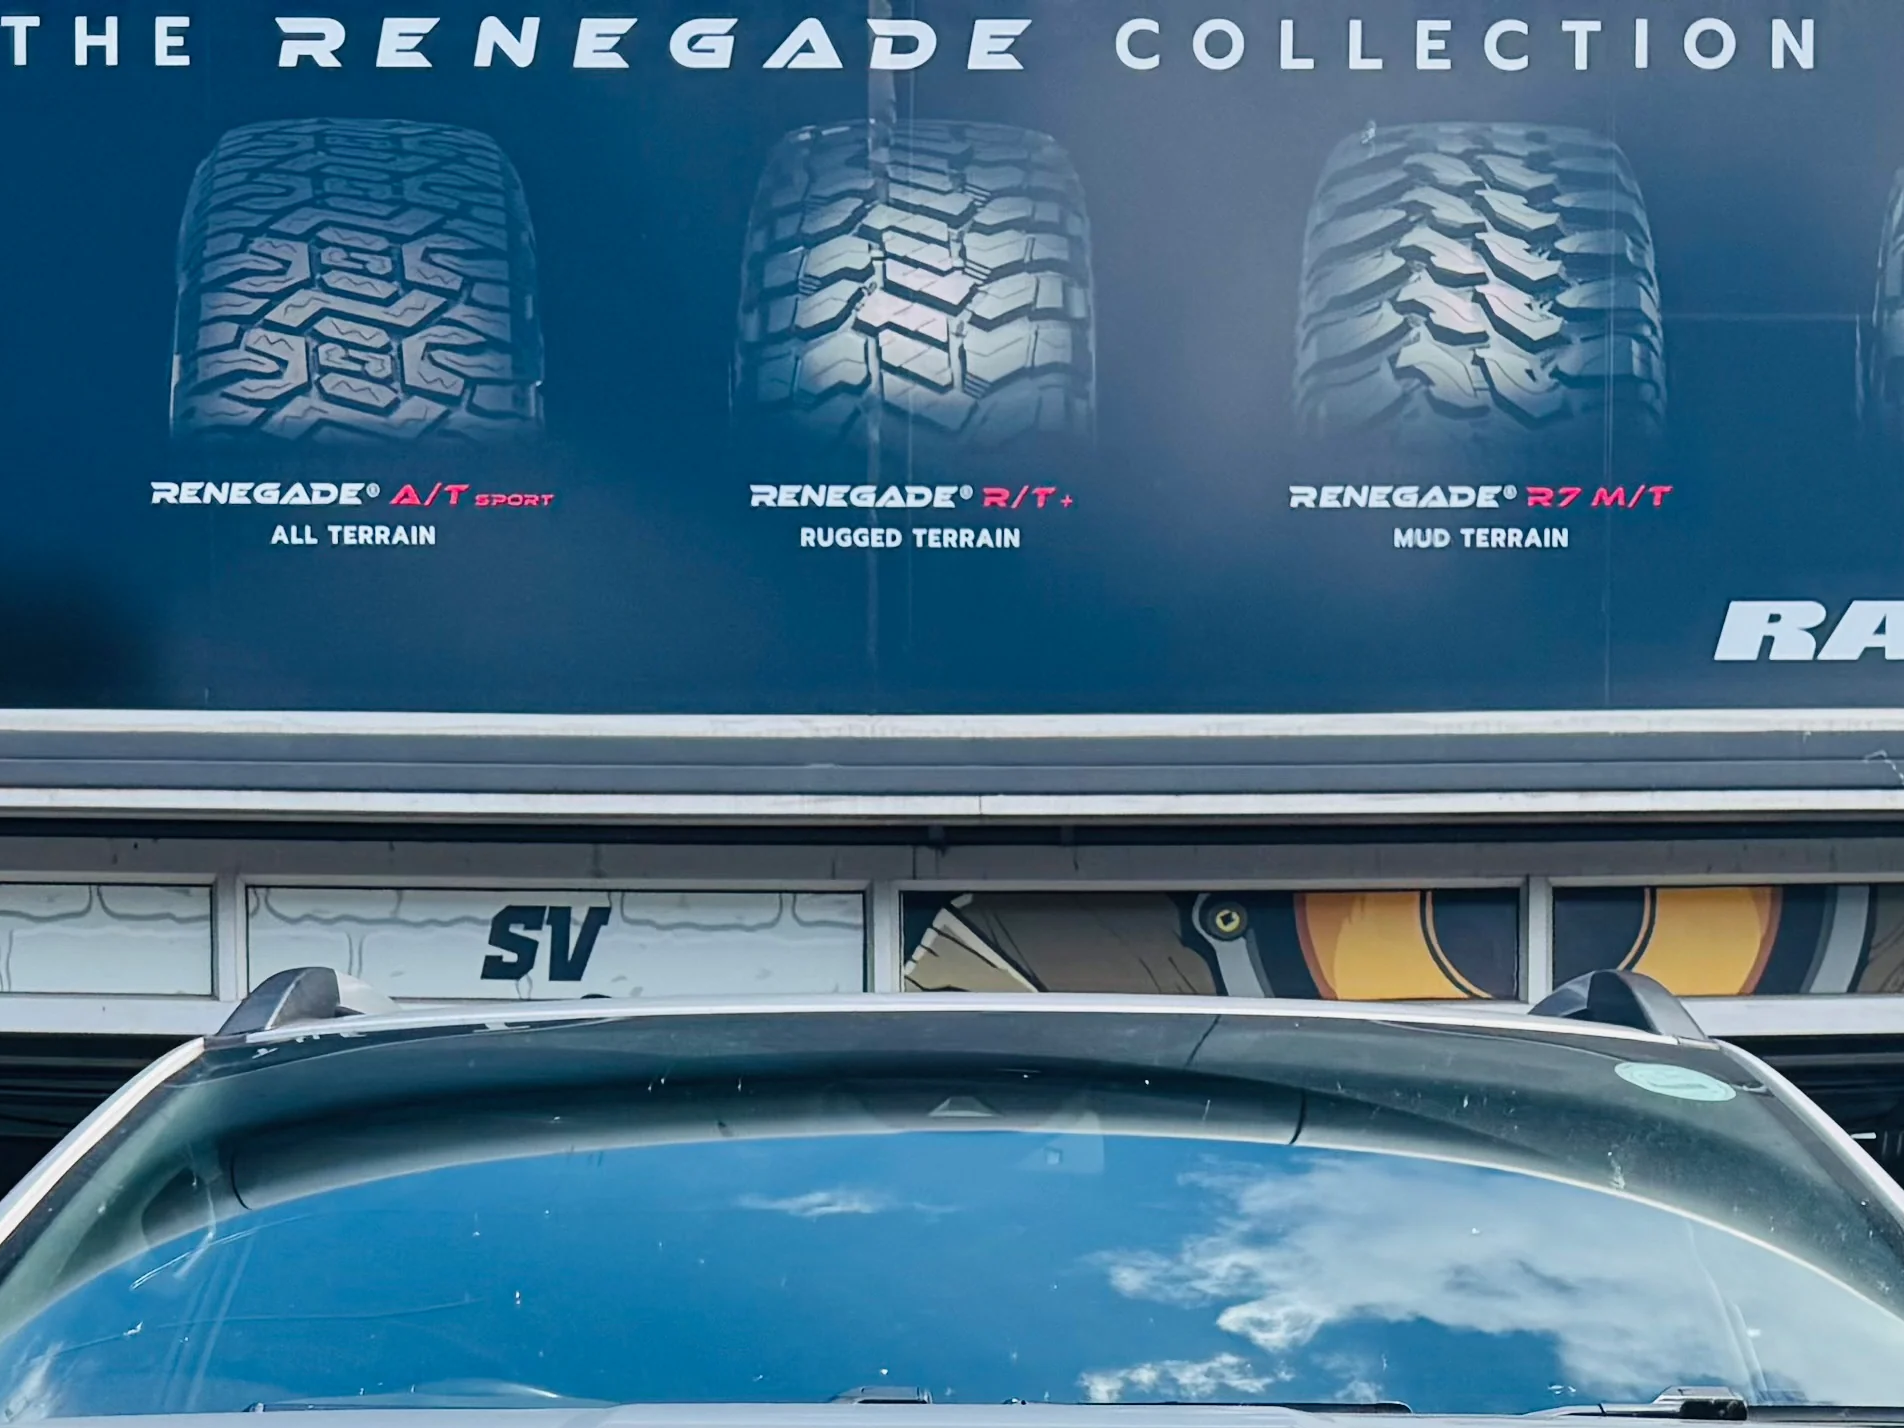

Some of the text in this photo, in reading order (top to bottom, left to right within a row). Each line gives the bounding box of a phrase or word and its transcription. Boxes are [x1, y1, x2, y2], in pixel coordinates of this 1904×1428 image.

[0, 15, 1815, 72] THE RENEGADE COLLECTION
[388, 482, 471, 507] A/T
[475, 493, 555, 507] SPORT
[1525, 486, 1584, 509] R7
[1590, 484, 1675, 509] M/T
[271, 524, 436, 545] ALL TERRAIN
[800, 526, 1021, 549] RUGGED TERRAIN
[1393, 527, 1569, 549] MUD TERRAIN
[479, 904, 610, 981] SV
